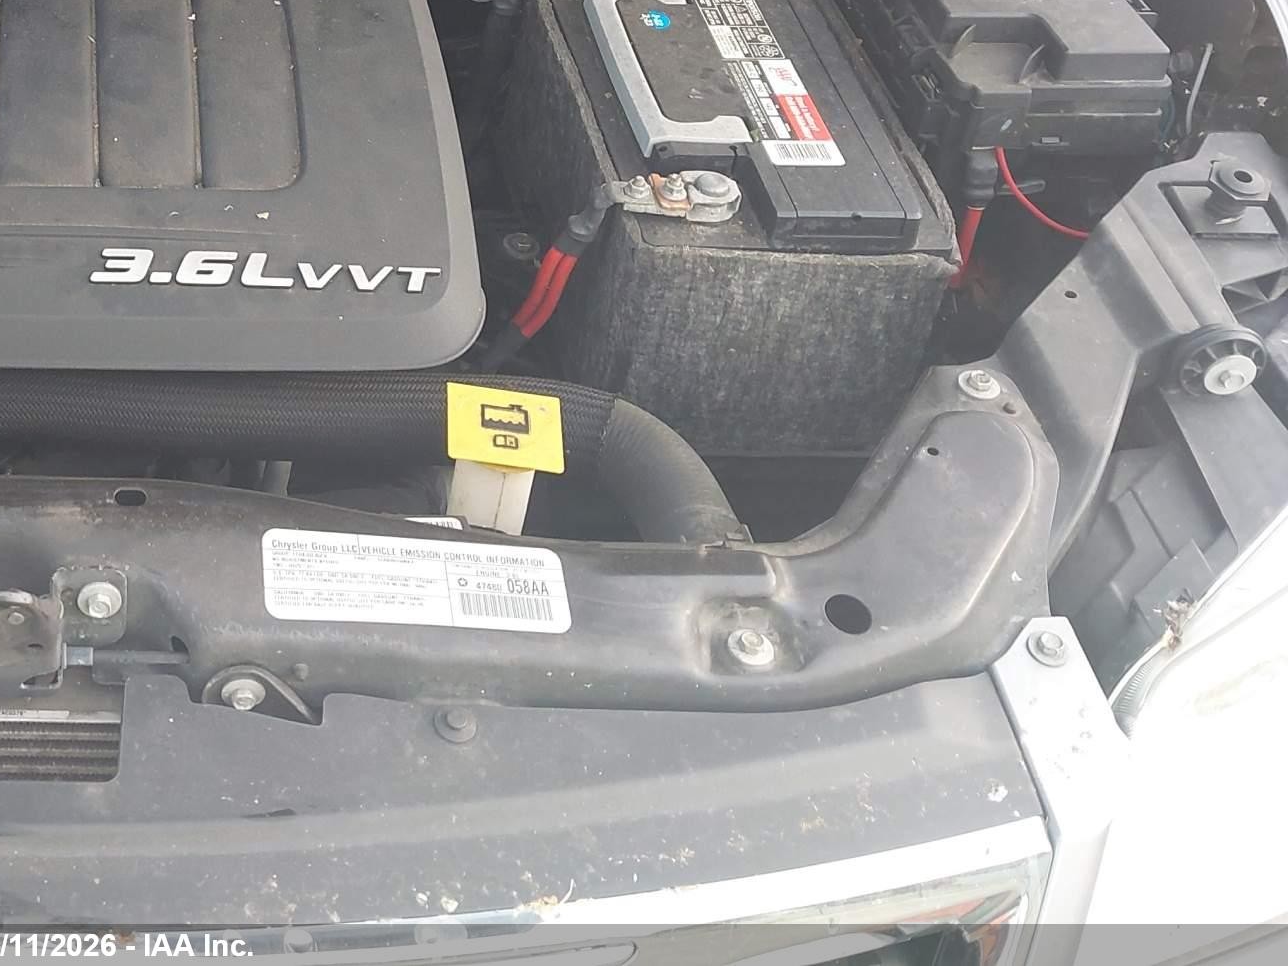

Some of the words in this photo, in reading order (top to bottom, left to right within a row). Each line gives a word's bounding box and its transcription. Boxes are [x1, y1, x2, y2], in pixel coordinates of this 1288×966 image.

[271, 538, 308, 551] Chrysler
[311, 542, 338, 553] Group
[341, 545, 358, 554] LLC
[362, 545, 396, 556] VEHICLE
[400, 548, 441, 560] EMISSION
[444, 551, 482, 563] CONTROL
[486, 553, 545, 567] INFORMATION
[507, 578, 550, 596] 058AA
